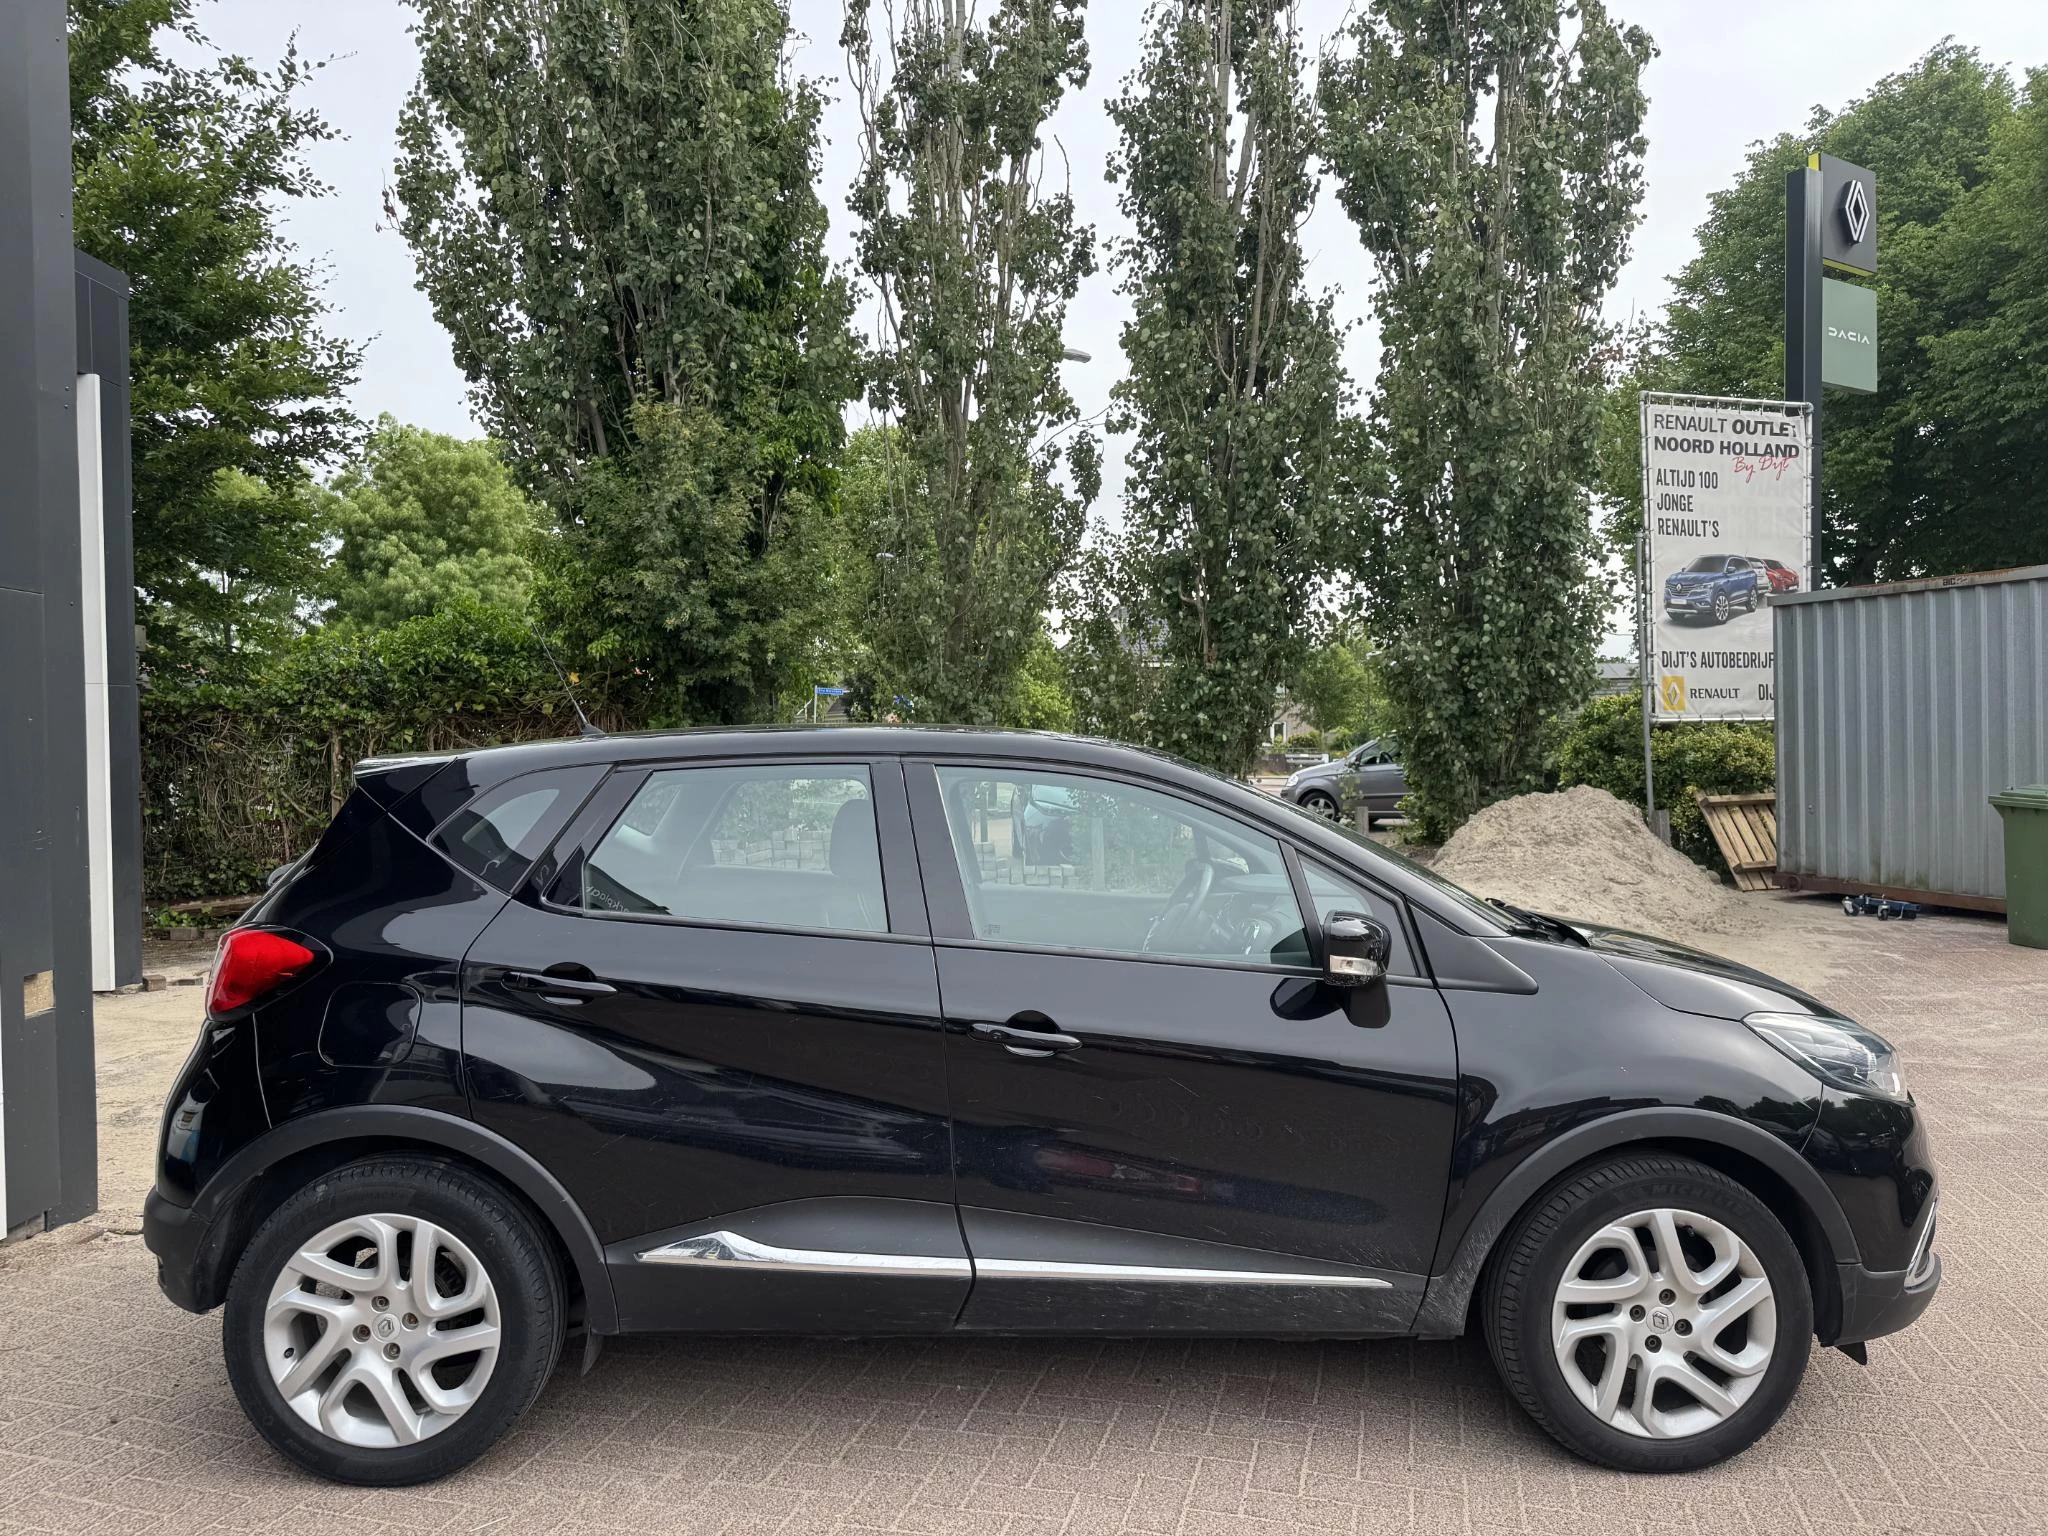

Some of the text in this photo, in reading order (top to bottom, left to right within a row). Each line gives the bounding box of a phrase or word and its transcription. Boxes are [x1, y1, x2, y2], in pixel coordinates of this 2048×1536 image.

[1828, 326, 1870, 345] DACIA
[1654, 414, 1727, 433] RENAULT
[1654, 436, 1799, 458] NOORD HOLLAND
[1656, 468, 1718, 489] ALTIJD 100
[1732, 456, 1756, 484] By
[1657, 492, 1694, 512] JONGE
[1658, 518, 1719, 537] RENAULT'S
[1662, 651, 1775, 669] DIJT'S AUTOBEDRIJF
[1690, 688, 1740, 699] RENAULT
